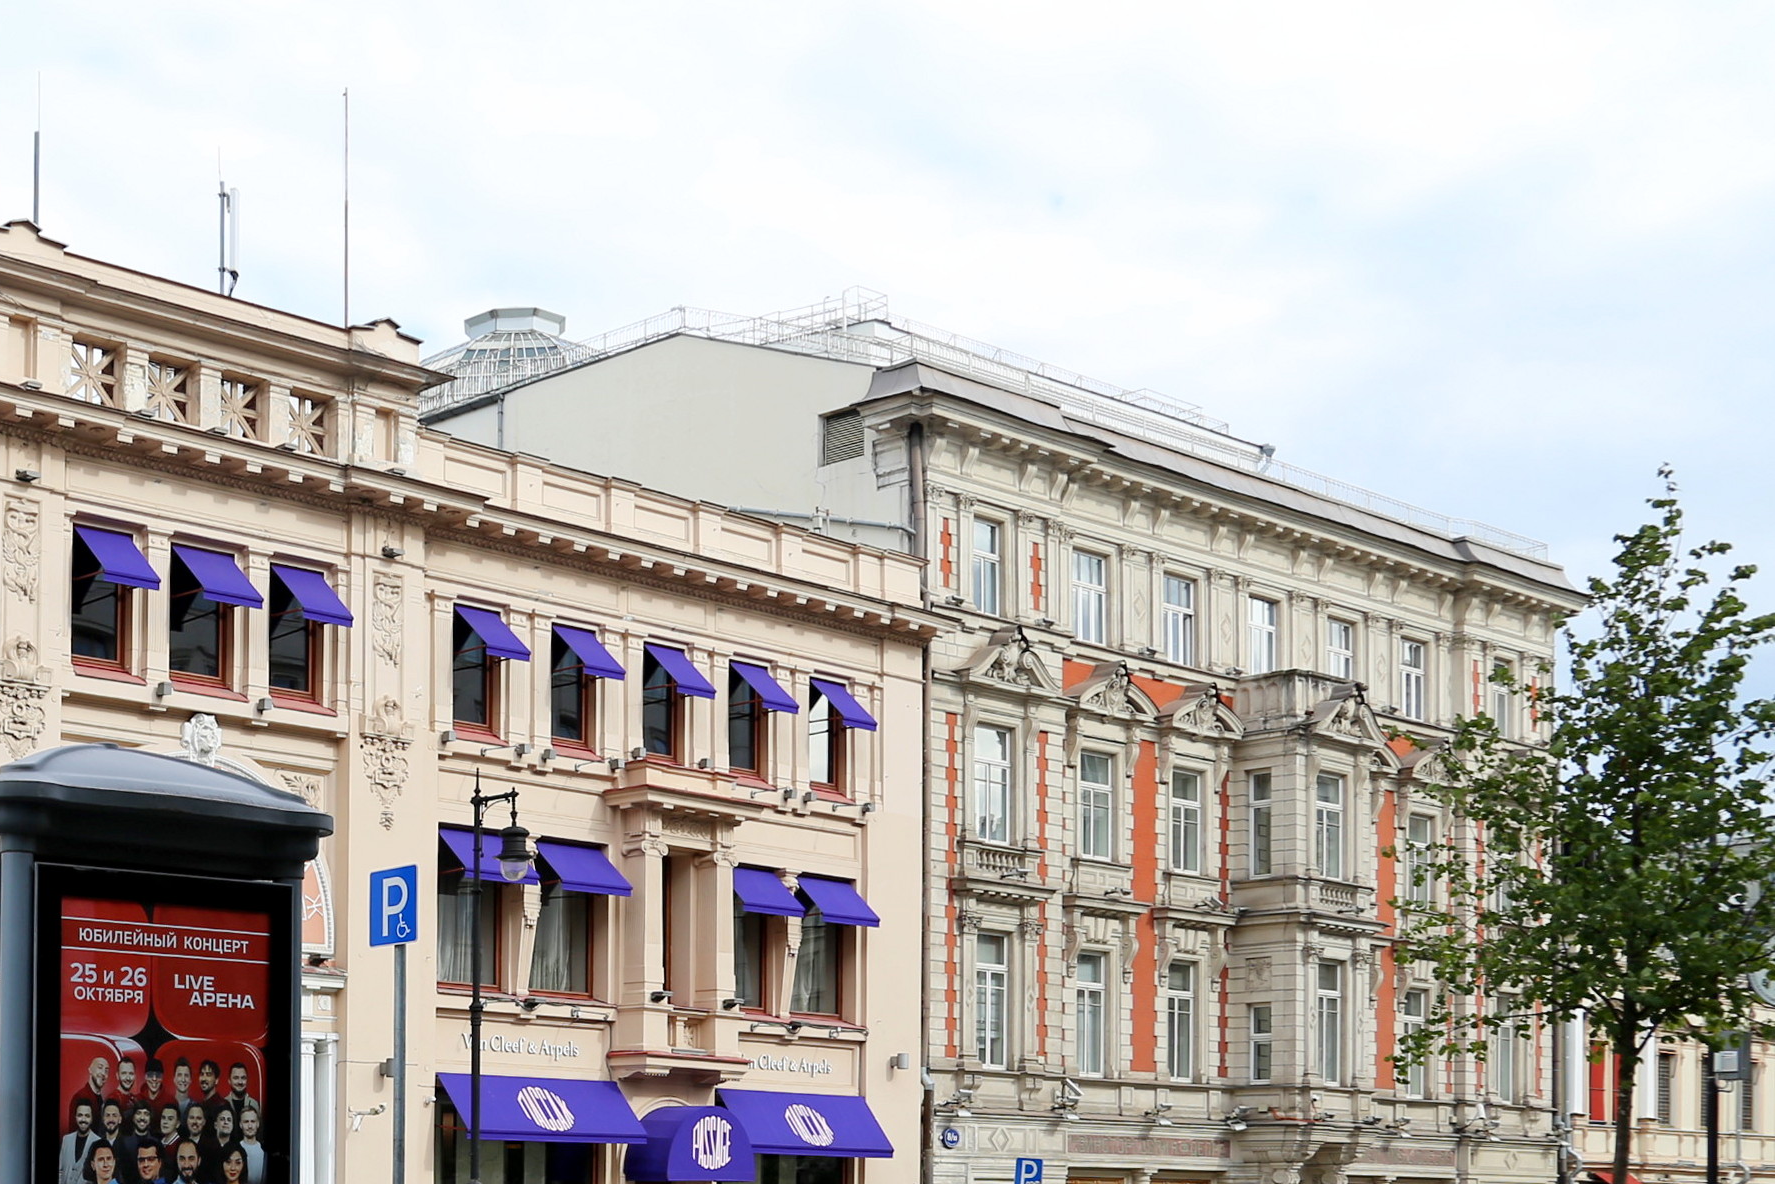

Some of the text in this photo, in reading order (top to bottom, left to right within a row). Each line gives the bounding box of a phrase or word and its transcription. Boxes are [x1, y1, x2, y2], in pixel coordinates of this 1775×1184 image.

[383, 877, 409, 937] P
[78, 927, 249, 955] ЮБИЛЕЙНЫЙ КОНЦЕРТ
[70, 962, 98, 983] 25
[120, 965, 147, 987] 26
[174, 973, 215, 991] LIVE
[73, 985, 144, 1004] ОКТЯБРЯ
[189, 990, 256, 1010] АРЕНА
[462, 1032, 579, 1061] Vn Cleef & Arpels
[758, 1054, 788, 1071] Cleef
[789, 1061, 798, 1072] &
[799, 1058, 833, 1078] Arpels
[692, 1115, 733, 1171] PASSAGE
